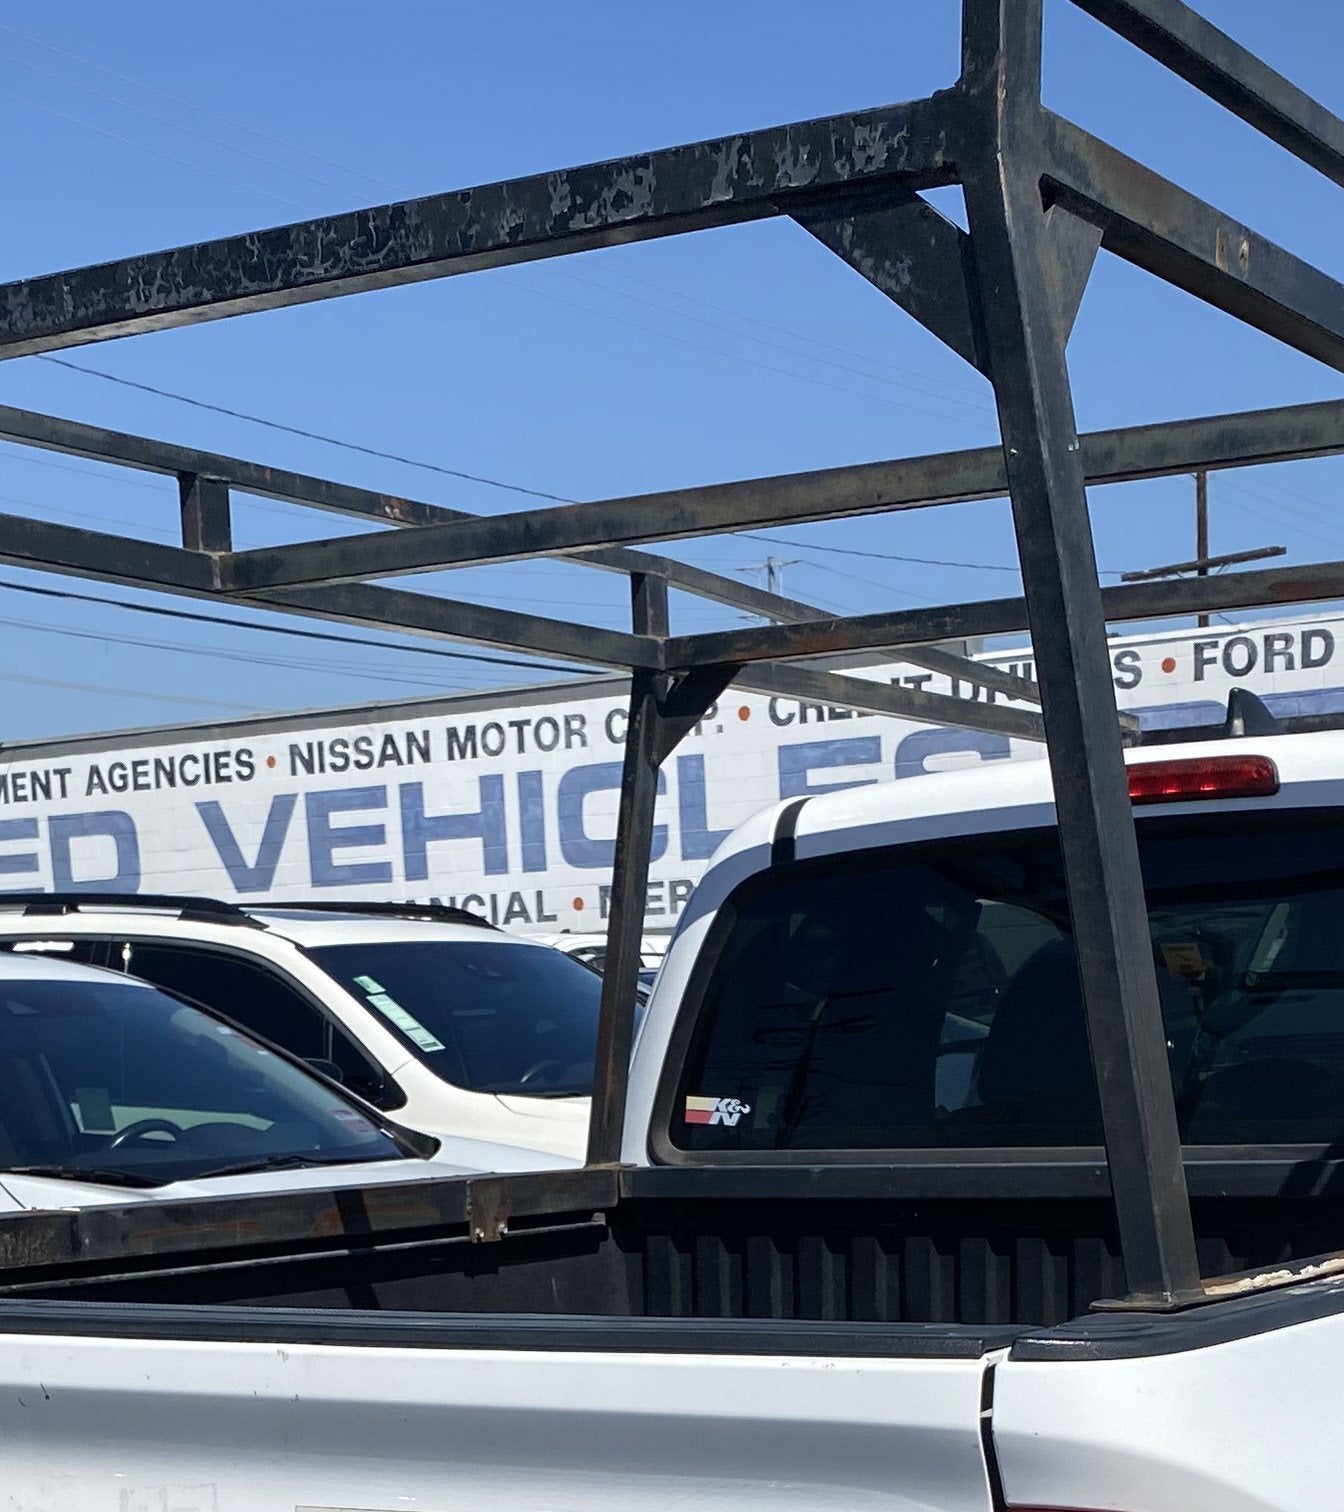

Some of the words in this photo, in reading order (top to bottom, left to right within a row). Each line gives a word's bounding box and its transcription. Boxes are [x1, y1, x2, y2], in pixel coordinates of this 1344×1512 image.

[85, 748, 255, 796] AGENCIES
[289, 729, 431, 776] NISSAN
[447, 712, 587, 761] MOTOR
[1194, 628, 1336, 681] FORD
